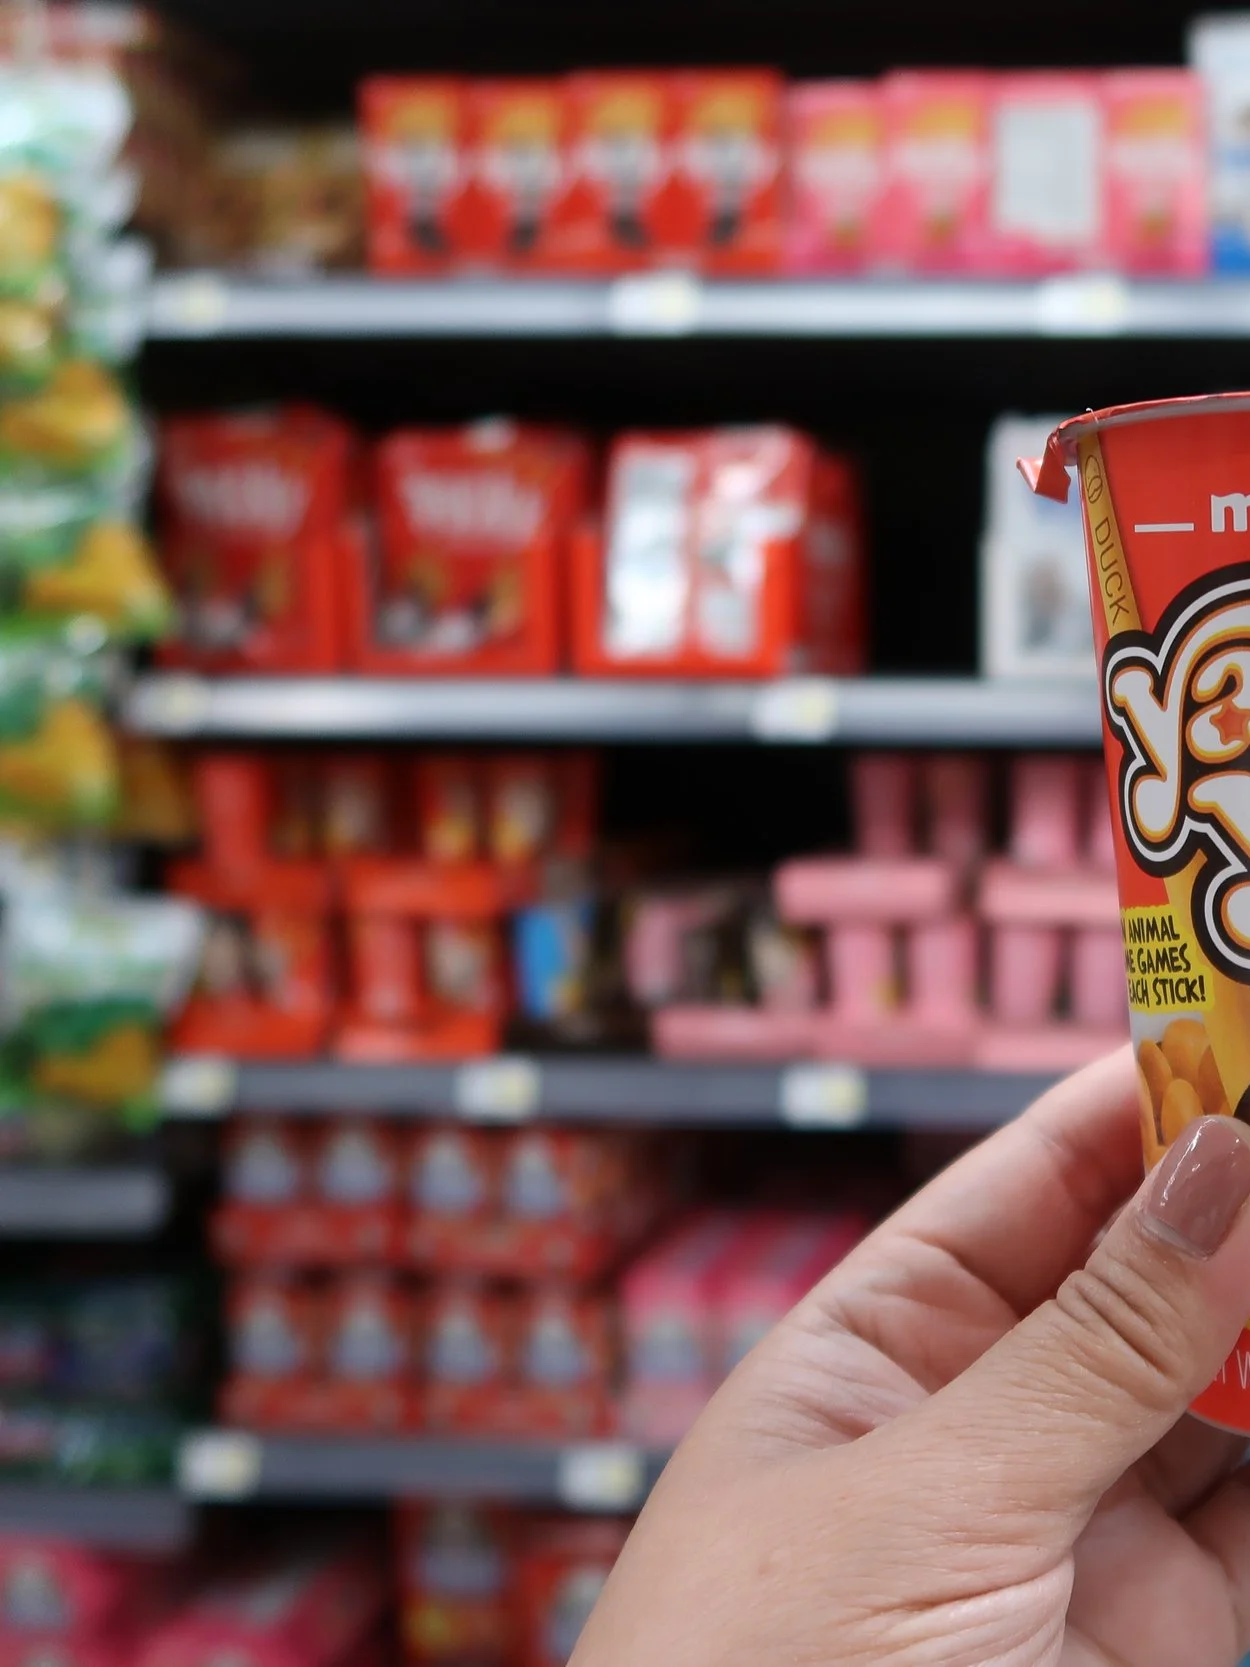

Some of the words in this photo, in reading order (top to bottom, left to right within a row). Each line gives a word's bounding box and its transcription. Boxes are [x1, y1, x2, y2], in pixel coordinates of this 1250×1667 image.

[1094, 519, 1119, 627] DUCK
[1128, 915, 1180, 944] ANIMAL
[1137, 943, 1191, 975] GAMES
[1152, 975, 1206, 1006] STICK!
